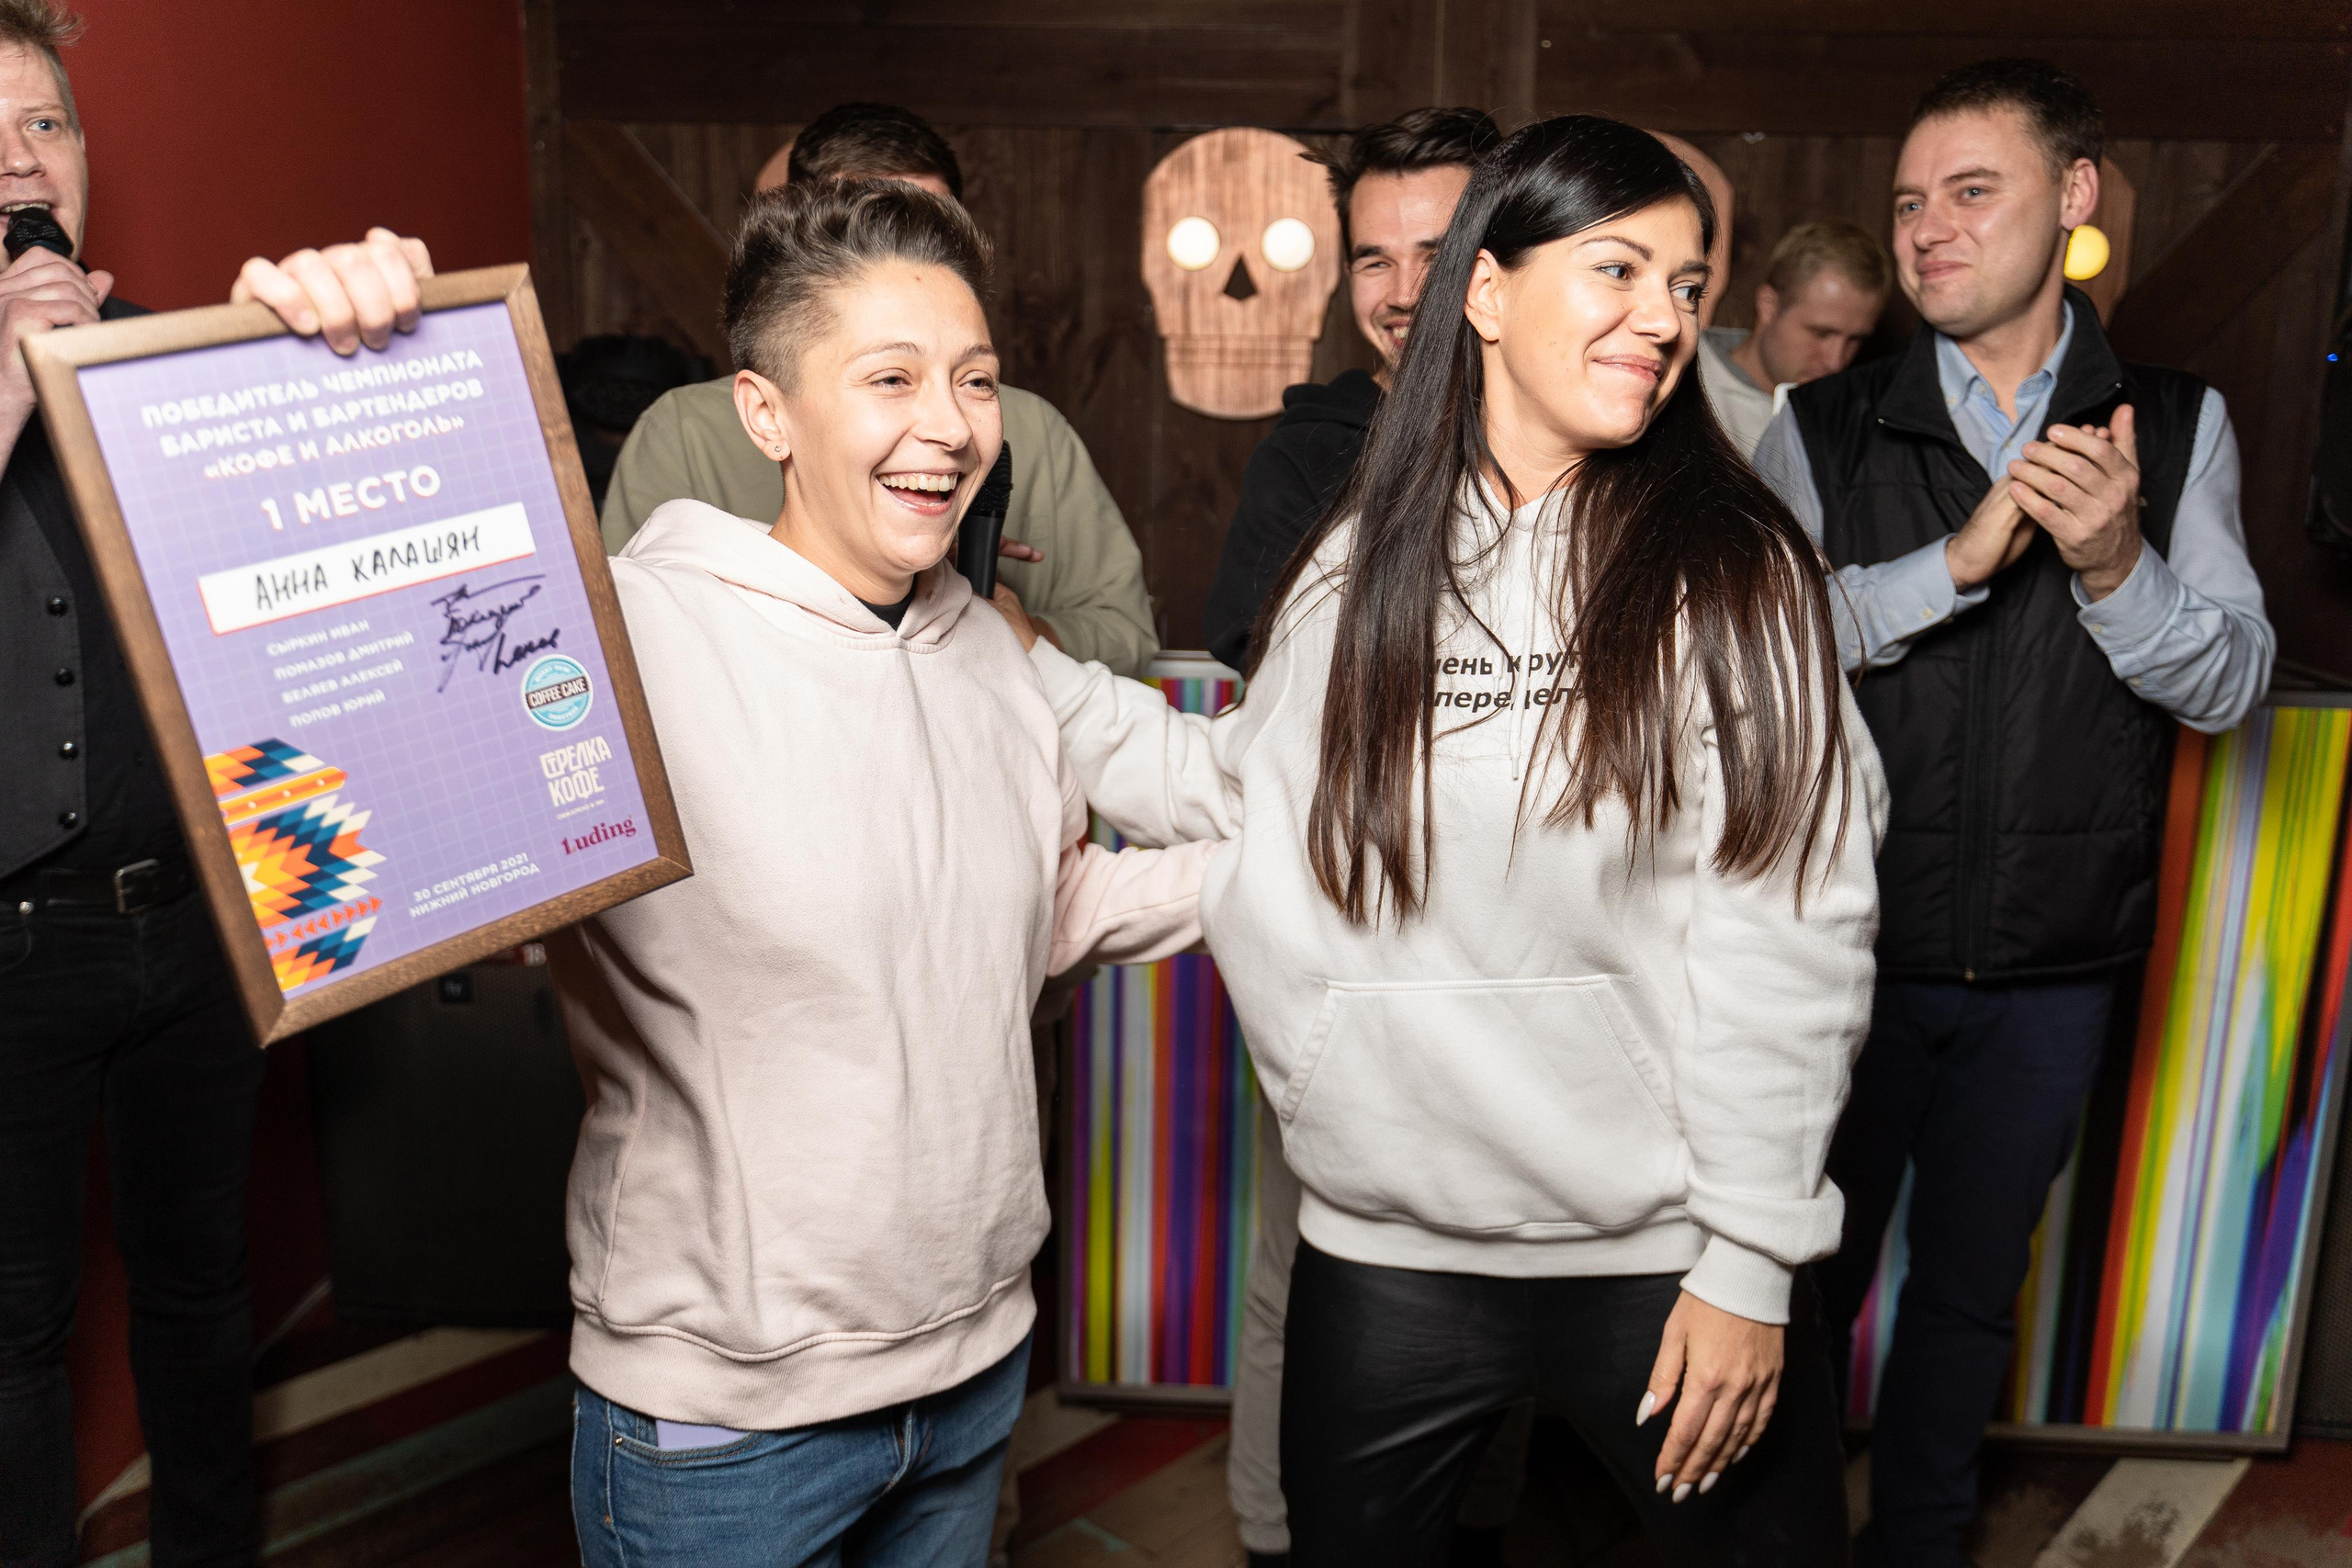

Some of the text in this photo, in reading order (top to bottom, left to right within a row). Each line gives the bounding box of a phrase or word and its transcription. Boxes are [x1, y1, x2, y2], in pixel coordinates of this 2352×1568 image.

[141, 349, 483, 428] ПОБЕДИТЕЛЬ ЧЕМПИОНАТА
[159, 378, 484, 457] БАРИСТА И БАРТЕНДЕРОВ
[204, 414, 466, 480] «КОФЕ И АЛКОГОЛЬ»
[261, 466, 441, 531] 1 МЕСТО
[255, 525, 481, 611] АННА КАЛАШЯН
[329, 619, 369, 639] ИВАН
[348, 630, 414, 661] ДМИТРИЙ
[341, 659, 403, 687] АЛЕКСЕЙ
[1434, 655, 1493, 675] ень
[289, 689, 386, 728] ПОПОВ ЮРИЙ
[528, 678, 586, 706] COFFEE CAKE
[548, 768, 605, 807] КОФЕ
[561, 817, 637, 856] Luding
[409, 863, 540, 918] НИЖНИЙ НОВГОРОД
[413, 852, 528, 902] 30 СЕНТЯБРЯ 2021
